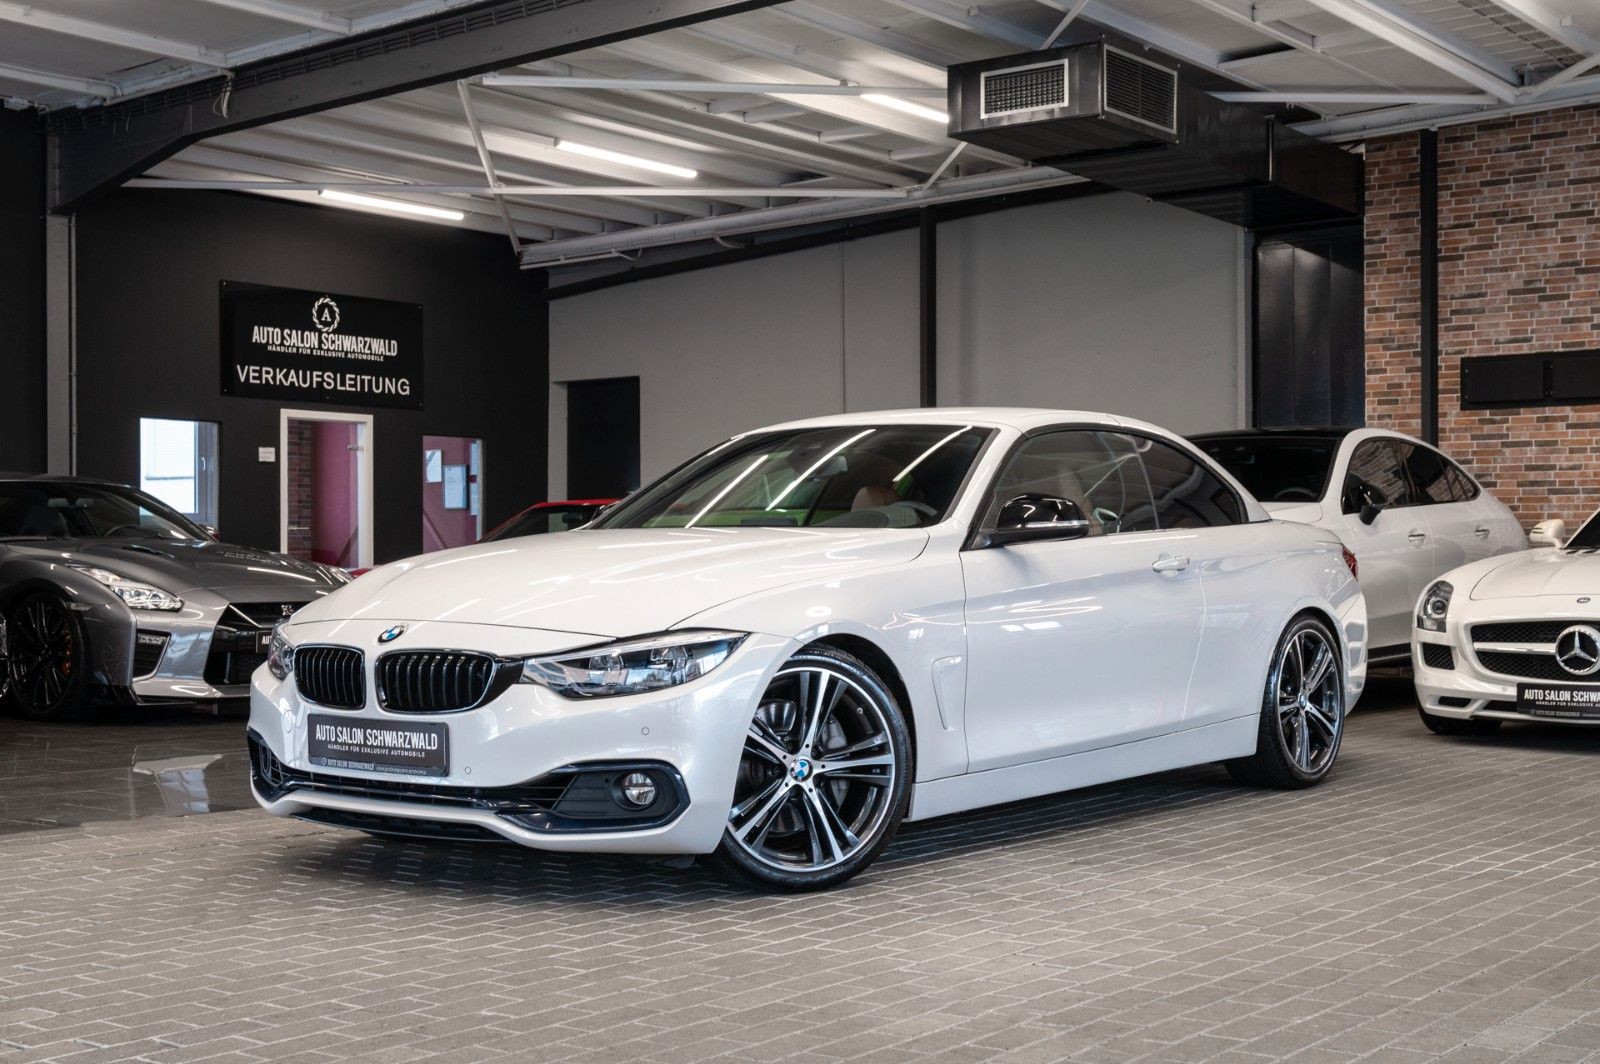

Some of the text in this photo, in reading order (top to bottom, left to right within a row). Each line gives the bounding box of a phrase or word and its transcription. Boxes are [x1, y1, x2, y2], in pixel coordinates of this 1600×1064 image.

[321, 309, 331, 321] A
[252, 326, 397, 356] AUTO SALON SCHWARZWALD
[298, 347, 311, 355] FÜR
[236, 364, 410, 395] VERKAUFSLEITUNG
[1524, 689, 1543, 700] AUTO
[1545, 690, 1571, 701] SALON
[316, 725, 437, 750] AUTO SALON SCHWARZWALD
